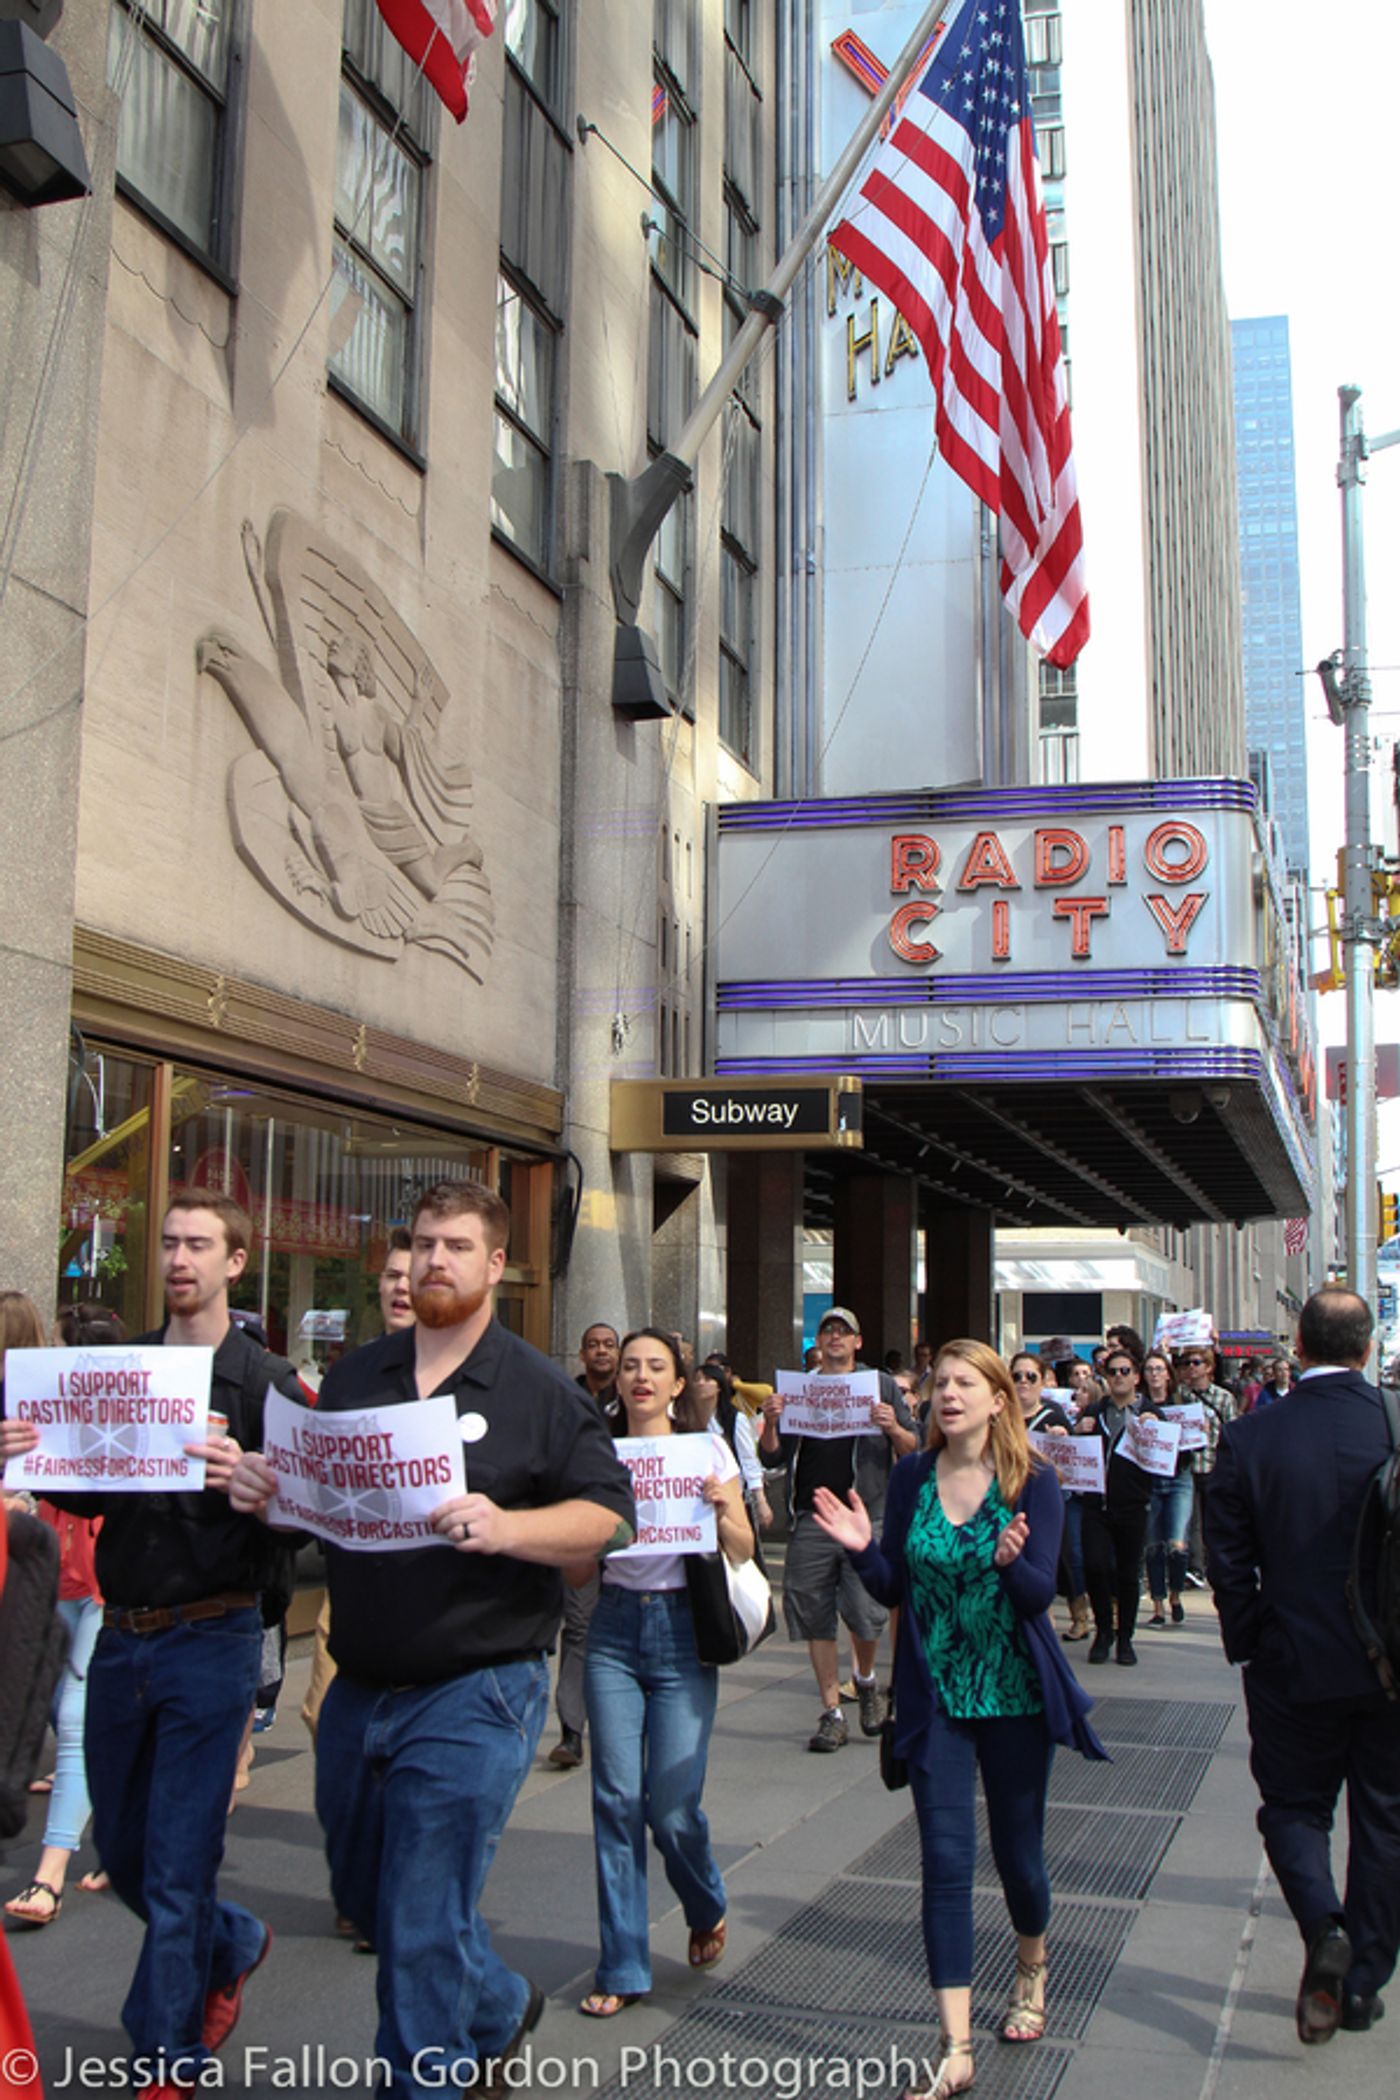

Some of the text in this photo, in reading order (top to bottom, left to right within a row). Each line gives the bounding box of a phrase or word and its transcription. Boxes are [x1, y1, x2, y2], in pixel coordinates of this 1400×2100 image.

[847, 297, 918, 400] HA
[890, 821, 1208, 895] RADIO
[889, 892, 1210, 964] CITY
[851, 1000, 1210, 1049] MUSIC HALL
[691, 1099, 799, 1128] Subway
[58, 1370, 152, 1397] I SUPPORT
[17, 1398, 195, 1425] CASTING DIRECTORS
[292, 1427, 393, 1463] I SUPPORT
[332, 1455, 451, 1489] DIRECTORS
[633, 1475, 705, 1501] RECTORS
